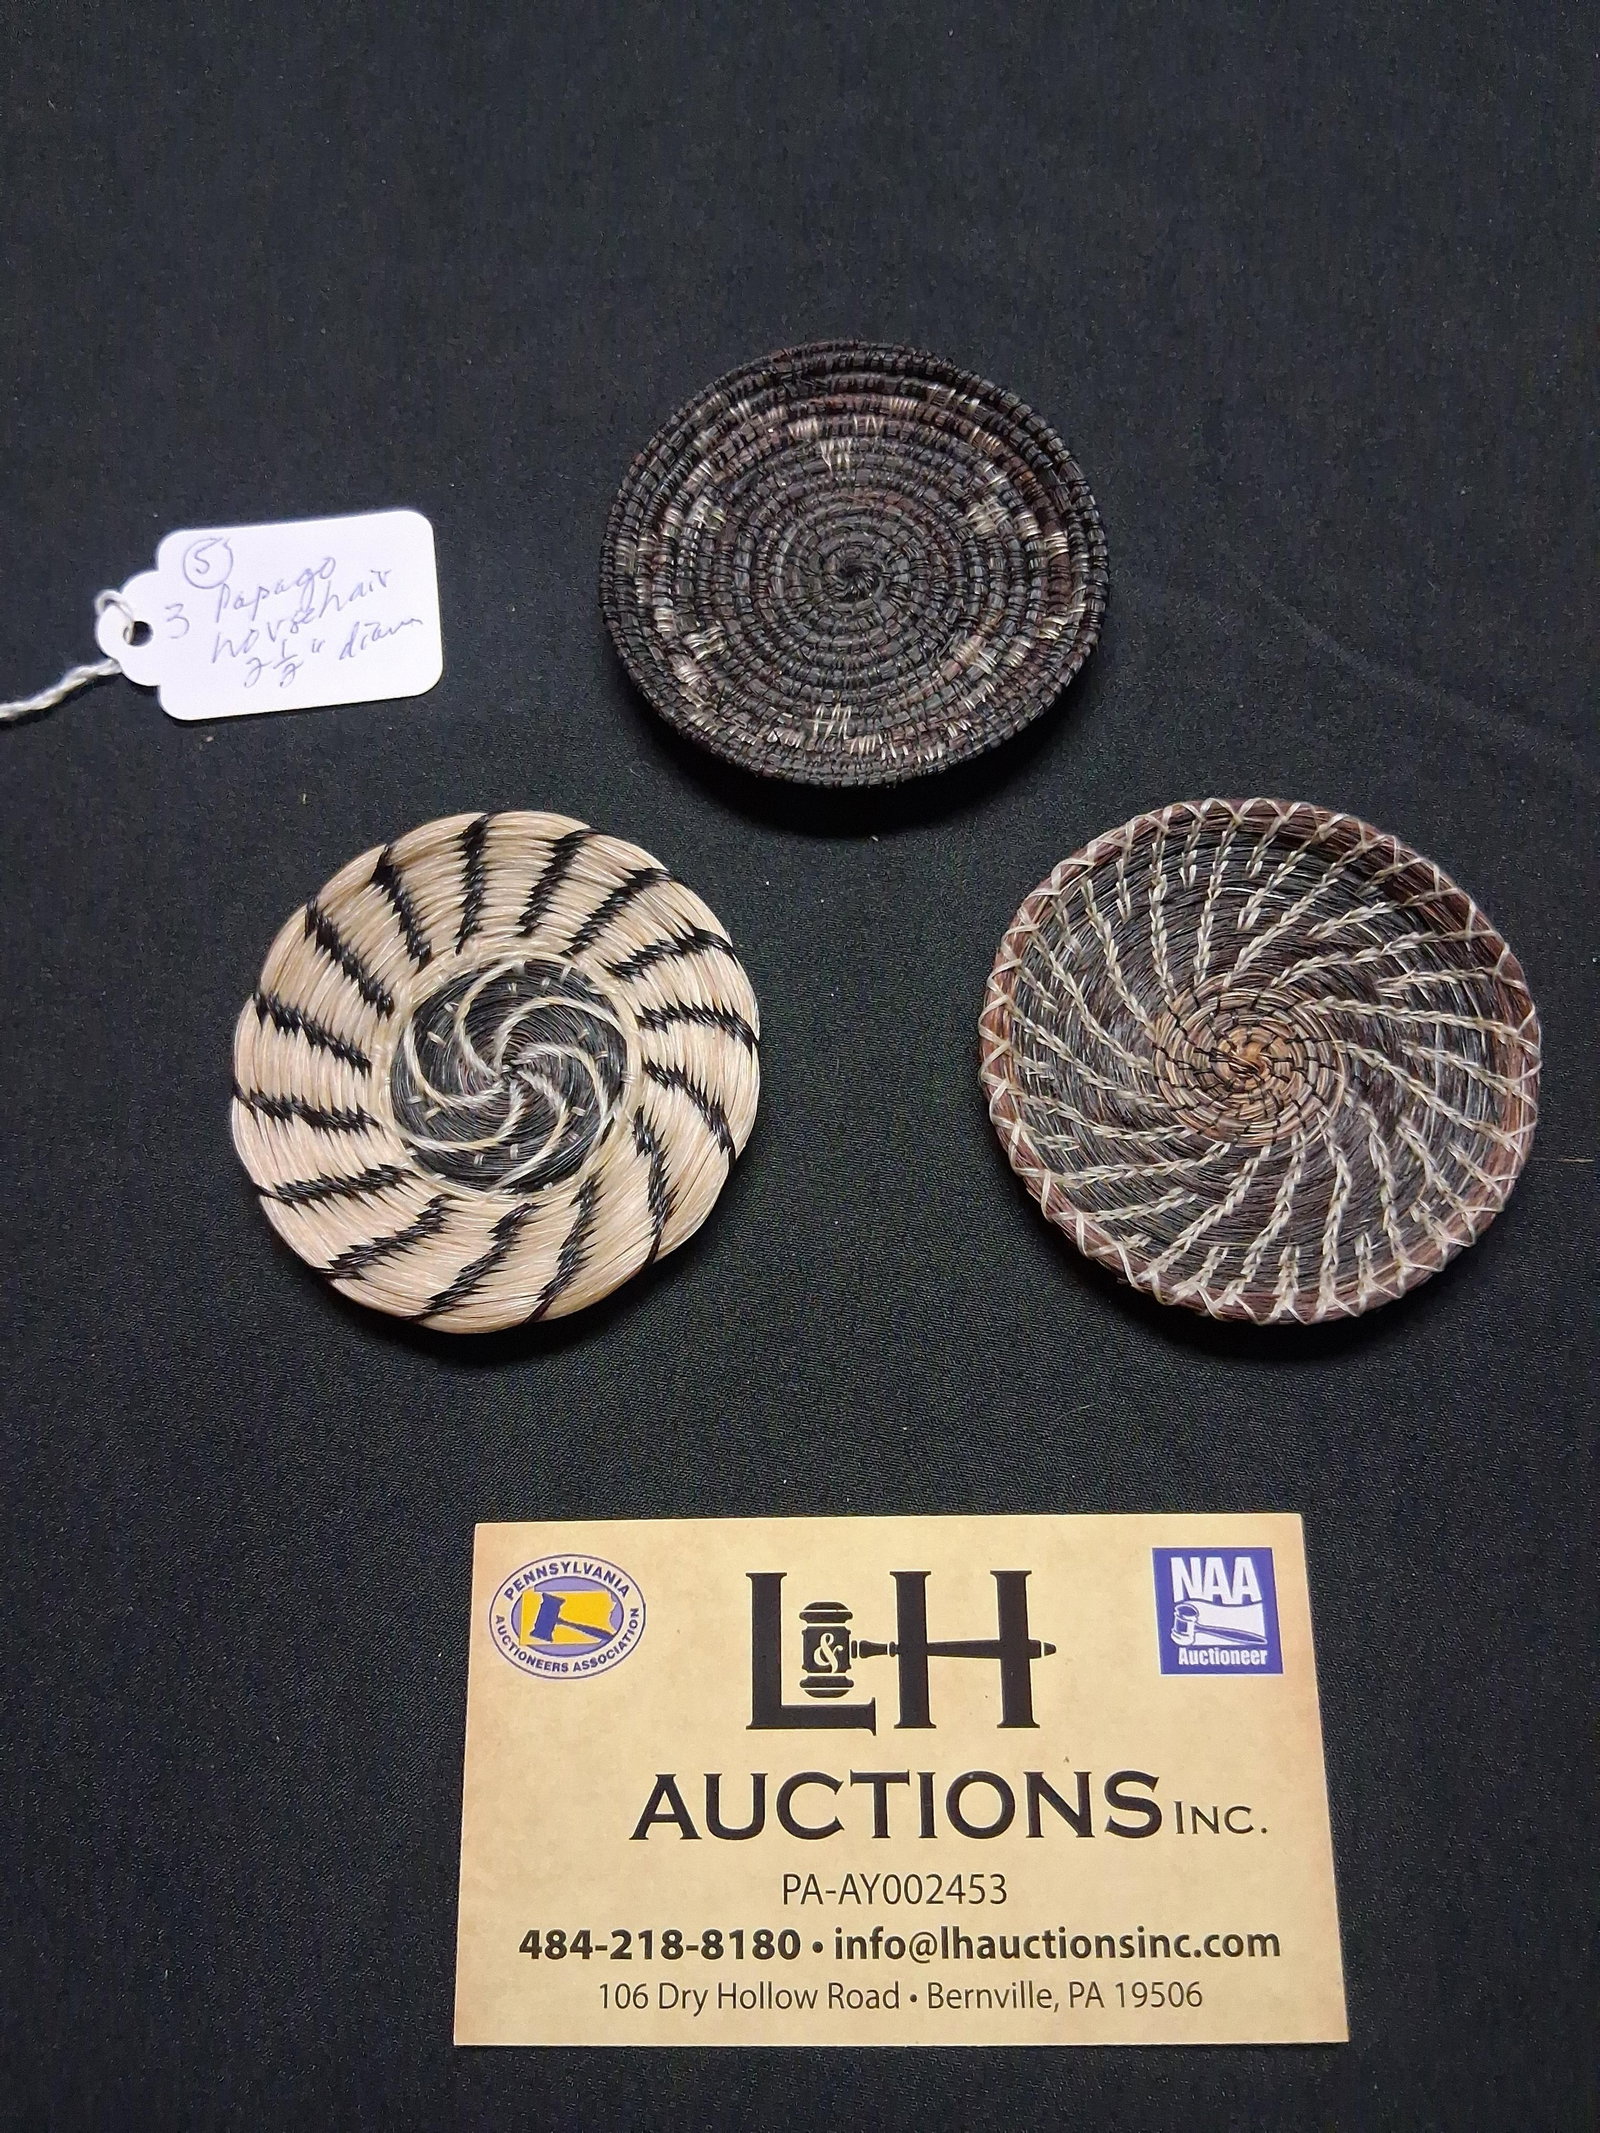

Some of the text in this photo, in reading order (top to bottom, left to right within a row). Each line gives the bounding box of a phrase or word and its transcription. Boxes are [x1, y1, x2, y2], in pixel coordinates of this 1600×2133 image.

[164, 557, 336, 639] 3 Papago
[503, 1561, 631, 1601] PENNSYLVANIA
[1170, 1556, 1263, 1605] NAA
[495, 1607, 640, 1673] AUCTIONEERS ASSOCIATION
[1178, 1647, 1268, 1665] Auctioneer
[629, 1770, 1268, 1840] AUCTIONS INC.
[783, 1873, 1007, 1905] PA-AY002453
[519, 1926, 1281, 1963] 484-218-8180 info@lhauctionsinc.com
[599, 1980, 1203, 2018] 106 Dry Hollow Road Bernville, PA 19506
